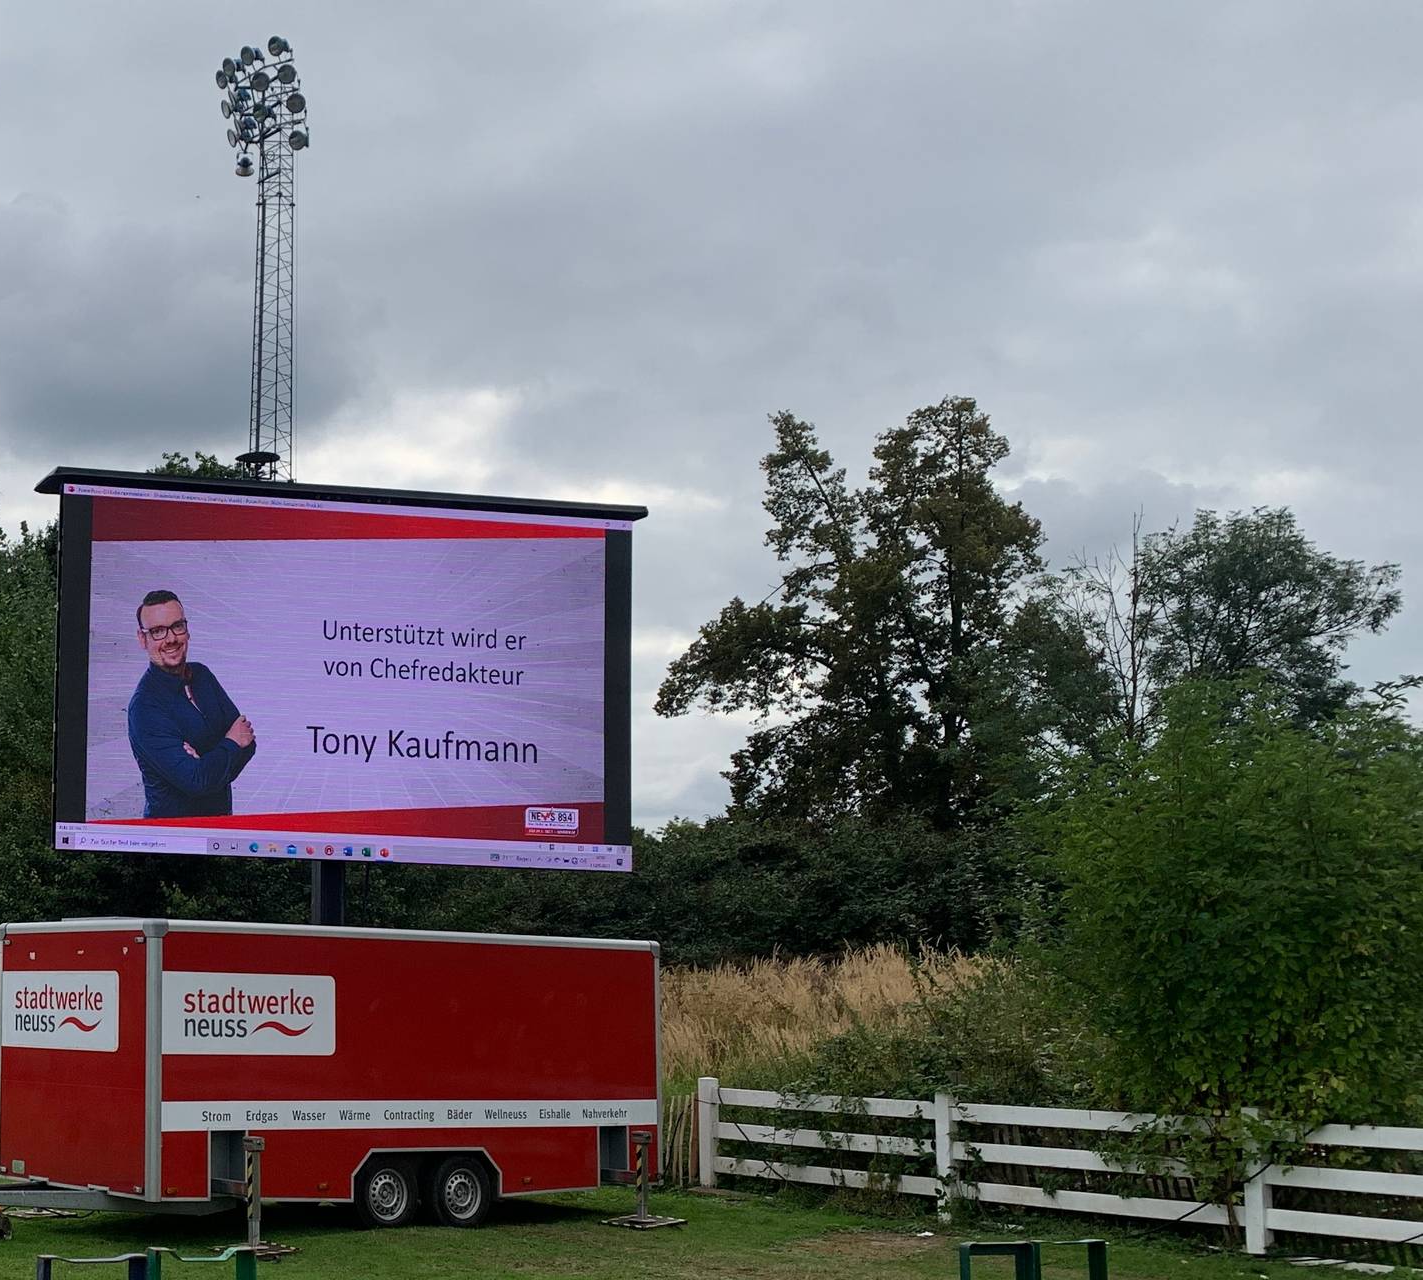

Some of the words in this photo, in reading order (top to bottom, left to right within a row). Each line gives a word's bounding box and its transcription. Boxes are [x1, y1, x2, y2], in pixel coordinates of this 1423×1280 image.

[323, 619, 445, 648] Unterstützt
[451, 625, 497, 651] wird
[504, 633, 527, 651] er
[323, 659, 362, 679] von
[369, 657, 525, 687] Chefredakteur
[305, 725, 378, 765] Tony
[387, 729, 538, 765] Kaufmann
[14, 983, 104, 1012] stadtwerke
[183, 986, 315, 1016] stadtwerke
[15, 1013, 56, 1033] neuss
[184, 1018, 248, 1038] neuss
[202, 1110, 232, 1122] Strom
[246, 1110, 279, 1123] Erdgas
[292, 1110, 327, 1121] Wasser
[339, 1109, 371, 1121] Wärme
[383, 1108, 435, 1122] Contracting
[447, 1108, 473, 1120] Bäder
[485, 1108, 528, 1120] Wellneuss
[539, 1108, 571, 1120] Eishalle
[582, 1107, 628, 1119] Nahverkehr
